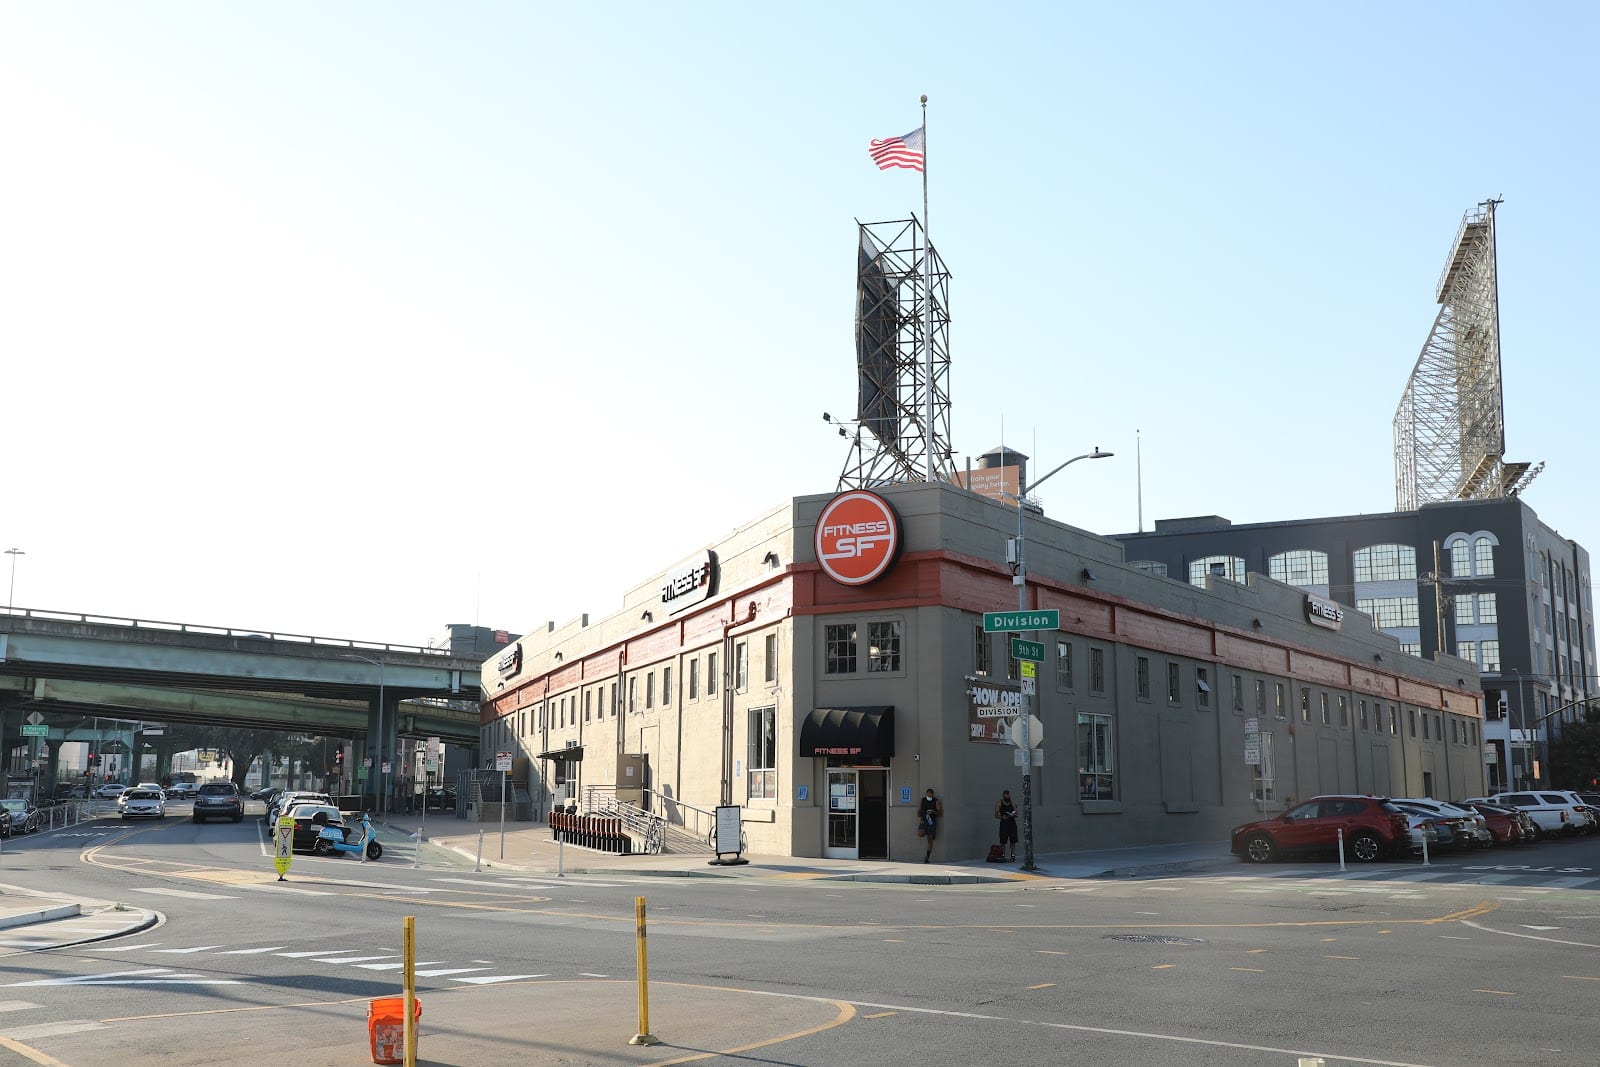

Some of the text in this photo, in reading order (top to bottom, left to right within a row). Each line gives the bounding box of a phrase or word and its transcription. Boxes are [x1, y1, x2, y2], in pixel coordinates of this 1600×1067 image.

[824, 520, 887, 537] FITNESS
[836, 535, 875, 559] SF
[994, 615, 1049, 627] Division
[1018, 644, 1039, 657] 9th St
[972, 686, 1021, 707] NOW OPE
[979, 707, 1018, 716] DIVISION
[814, 747, 862, 755] FITNESS SF
